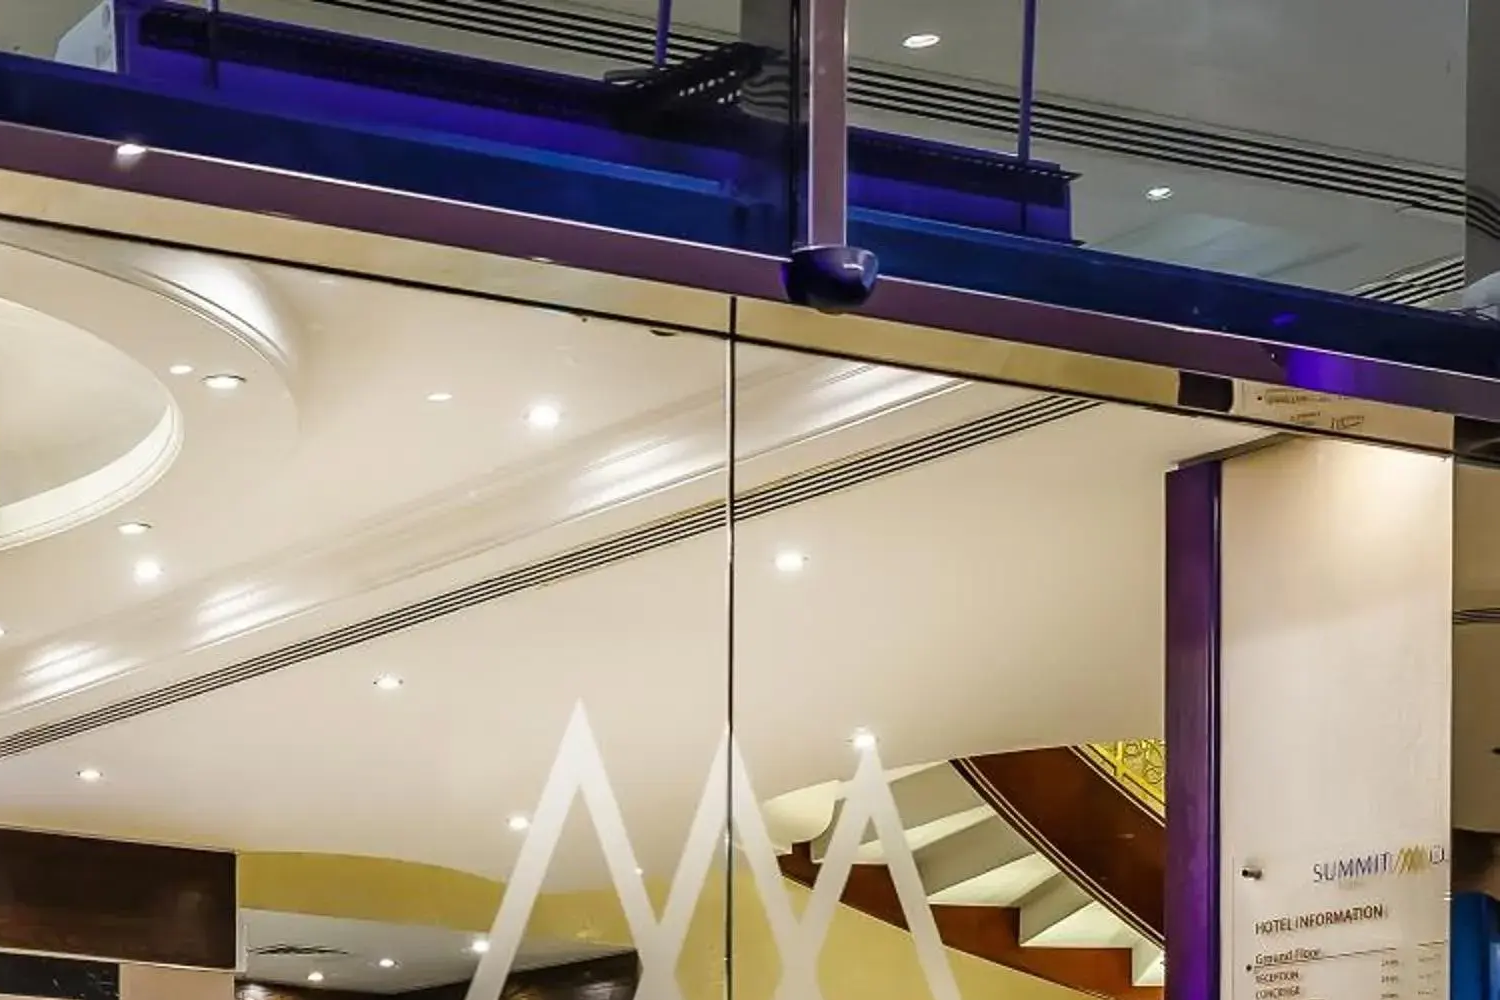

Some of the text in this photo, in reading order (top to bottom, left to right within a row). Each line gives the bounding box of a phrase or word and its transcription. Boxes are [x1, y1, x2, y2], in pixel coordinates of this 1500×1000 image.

[1313, 851, 1390, 882] SUMMIT
[1255, 903, 1384, 935] HOTEL INFORMATION
